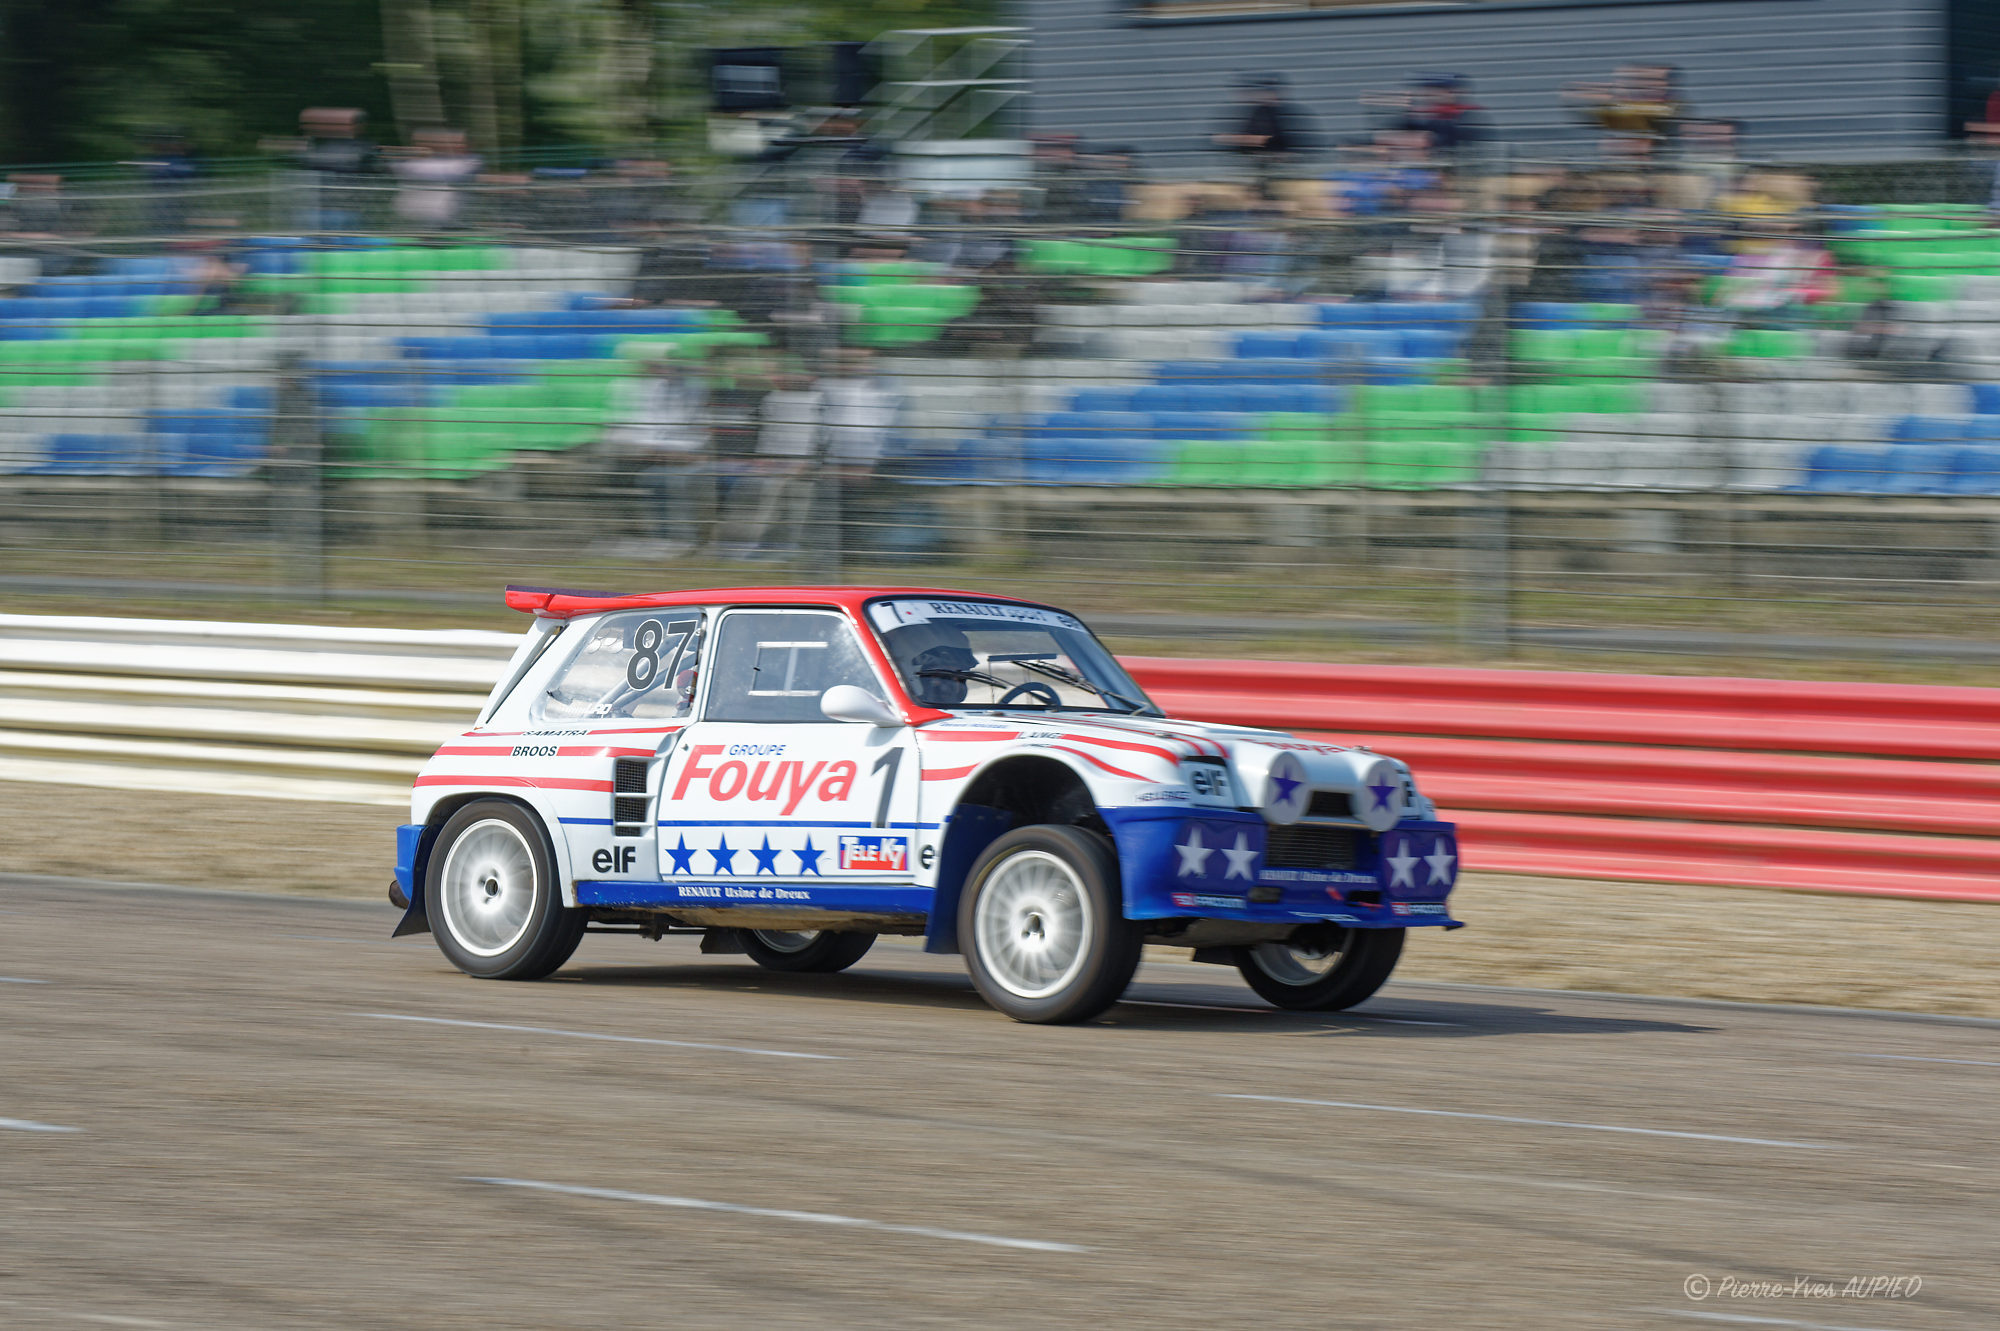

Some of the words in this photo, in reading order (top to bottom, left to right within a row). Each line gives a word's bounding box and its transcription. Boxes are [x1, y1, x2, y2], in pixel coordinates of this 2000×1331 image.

[928, 601, 1005, 618] RENAULT
[626, 618, 699, 692] 87
[512, 745, 558, 757] BROOS
[729, 744, 786, 756] GROUPE
[671, 744, 858, 816] Fouya
[870, 746, 904, 828] 1
[592, 845, 636, 873] elf
[677, 885, 722, 898] RENAULT
[724, 887, 758, 899] Usine
[758, 887, 775, 899] de
[775, 888, 812, 900] Dreux
